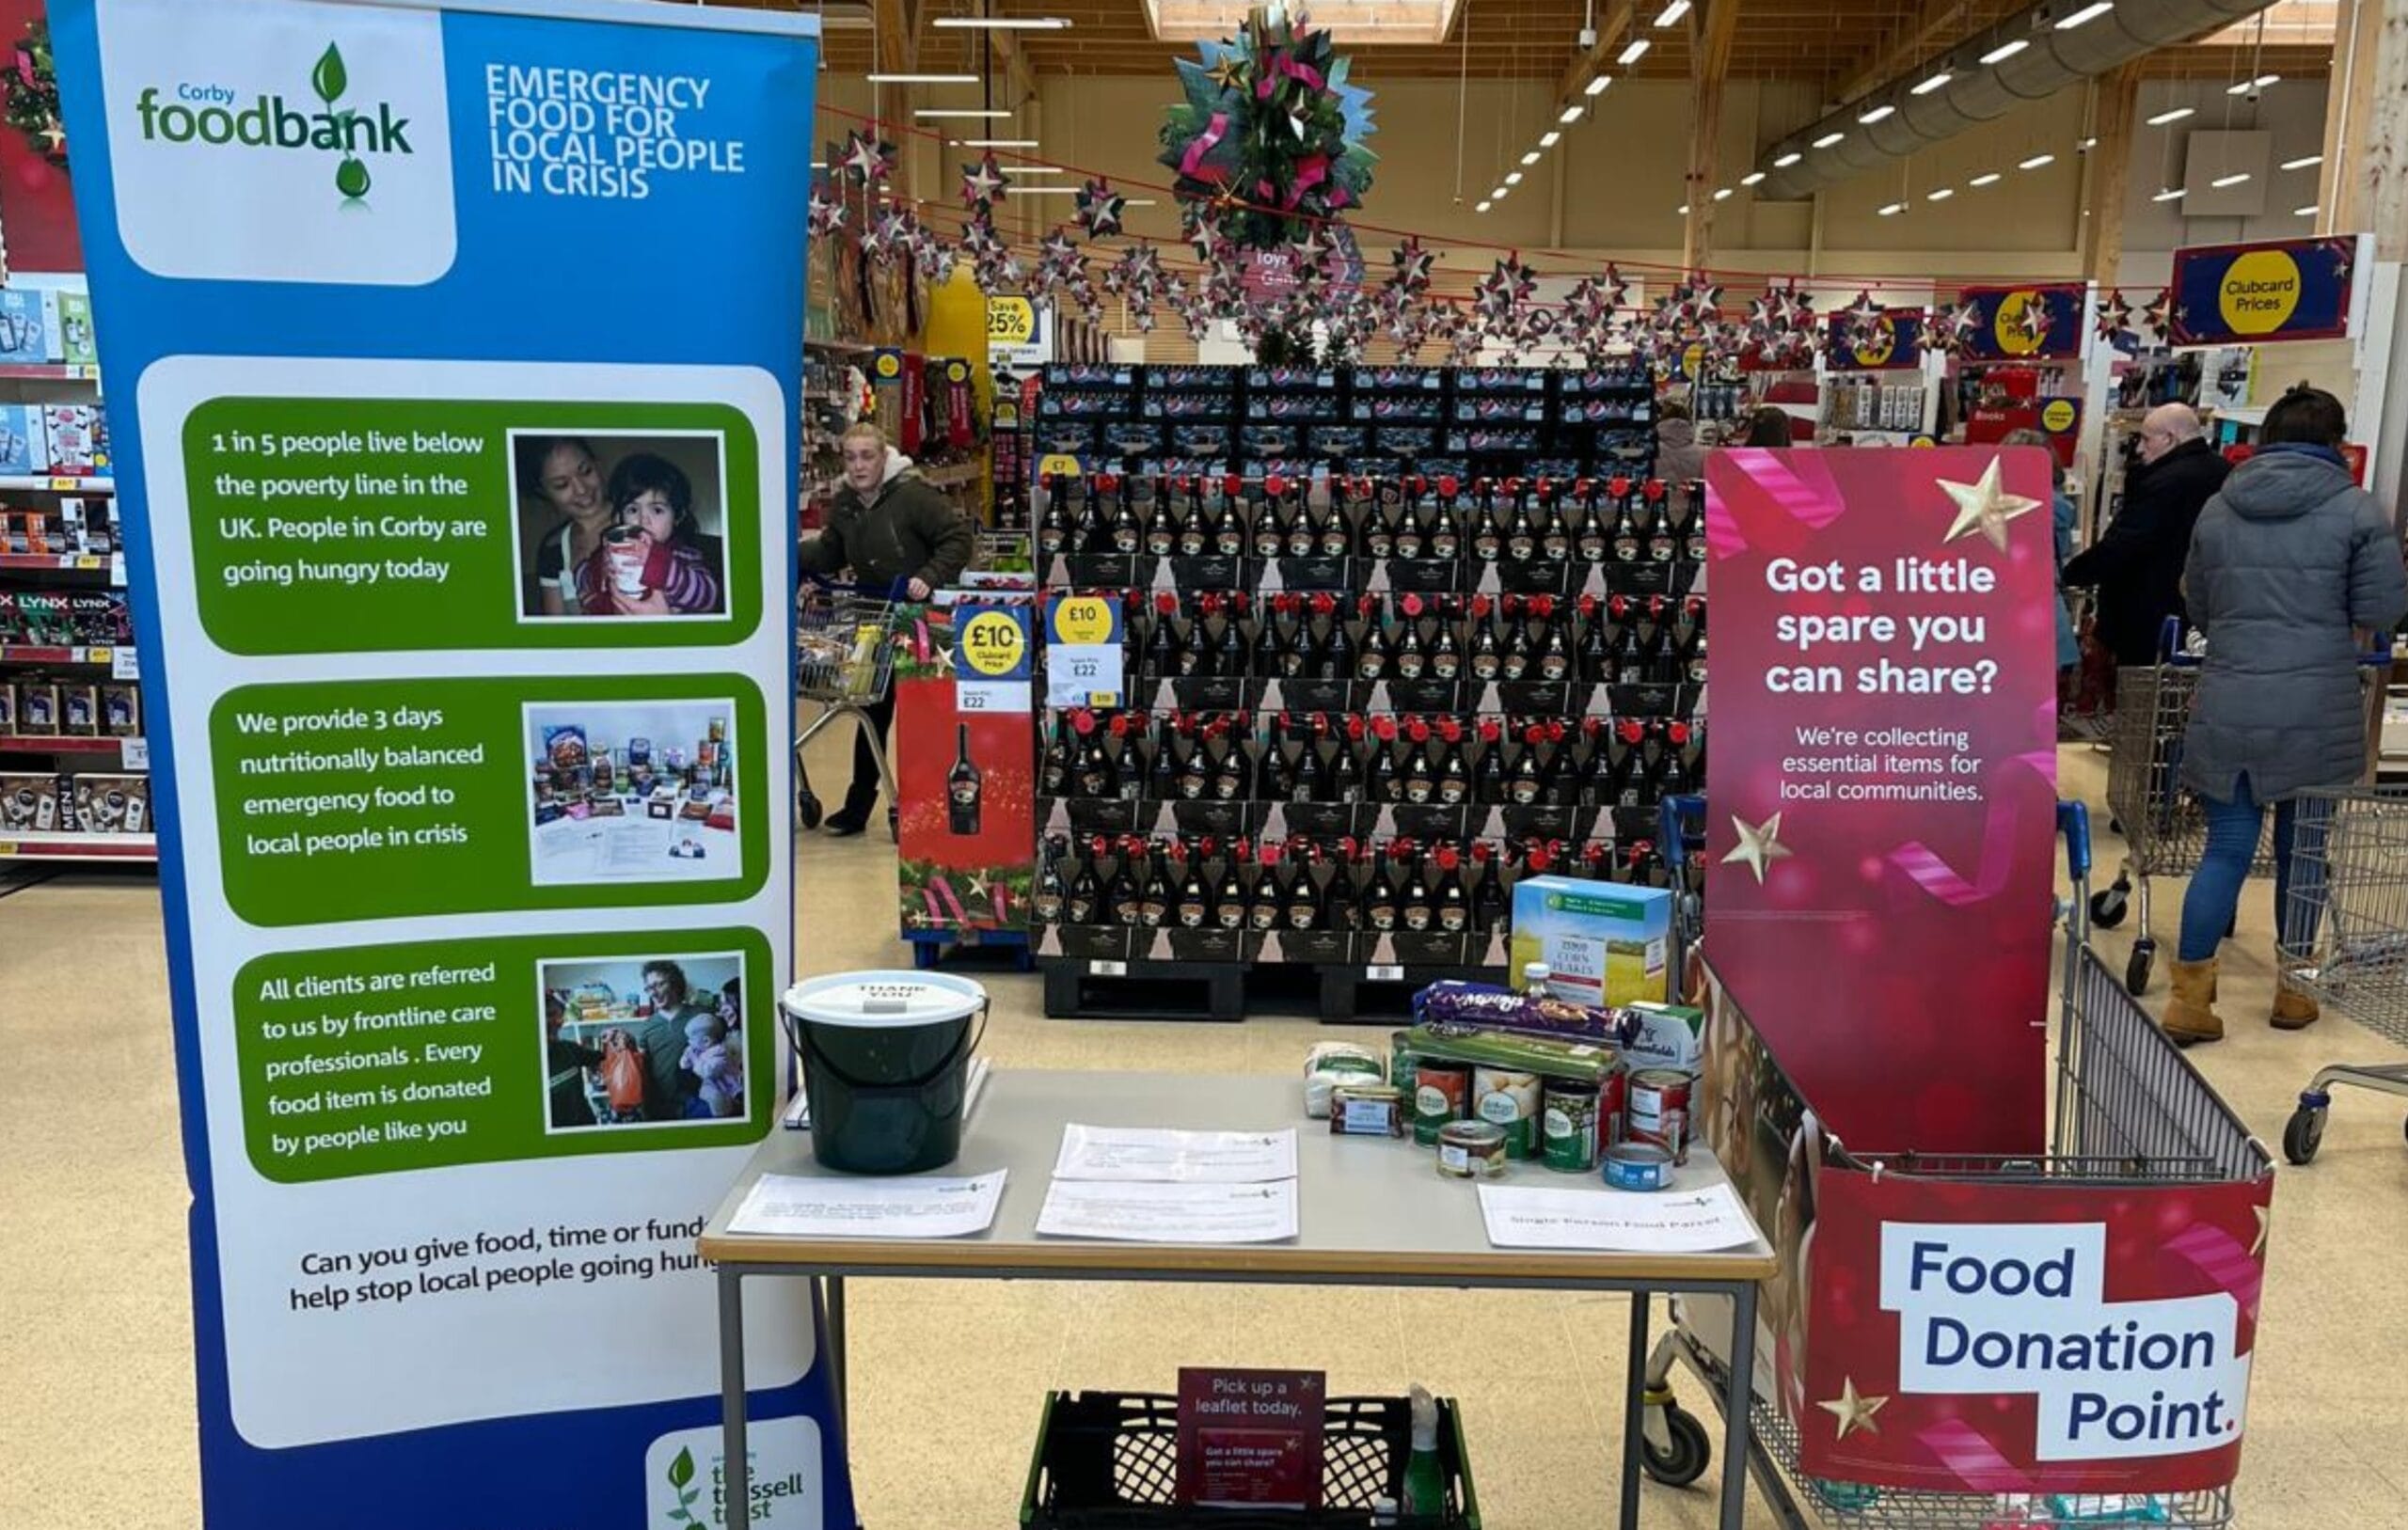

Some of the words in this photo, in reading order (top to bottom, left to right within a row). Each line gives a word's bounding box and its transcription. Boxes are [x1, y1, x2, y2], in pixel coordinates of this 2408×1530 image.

[179, 83, 234, 103] Corby
[485, 64, 710, 109] EMERGENCY
[137, 87, 414, 153] foodbank
[489, 97, 595, 134] FOOD
[607, 105, 676, 137] FOR
[490, 128, 606, 166] LOCAL
[615, 136, 745, 172] PEOPLE
[493, 161, 531, 193] IN
[543, 164, 649, 198] CRISIS
[2226, 277, 2293, 295] Clubcard
[990, 301, 1019, 311] Save
[2236, 297, 2281, 312] Prices
[989, 313, 1026, 333] 25%
[213, 434, 226, 452] 1
[232, 431, 255, 451] in
[261, 434, 276, 455] 5
[282, 431, 361, 457] people
[368, 431, 406, 452] live
[413, 431, 483, 452] below
[215, 474, 255, 495] the
[261, 475, 349, 500] poverty
[355, 474, 398, 495] line
[403, 474, 424, 495] in
[430, 474, 467, 495] the
[219, 518, 262, 538] UK.
[268, 516, 347, 542] People
[353, 516, 374, 536] in
[380, 516, 446, 541] Corby
[451, 520, 486, 536] are
[224, 560, 292, 587] going
[298, 559, 380, 584] hungry
[386, 557, 450, 582] today
[1766, 559, 1846, 592] Got
[1859, 566, 1881, 591] a
[1895, 558, 1995, 592] little
[19, 596, 68, 609] LYNX
[72, 598, 111, 607] LYNX
[1069, 606, 1097, 621] £10
[972, 624, 1015, 647] £10
[1777, 615, 1896, 651] spare
[1909, 616, 1985, 651] you
[1073, 664, 1097, 676] £22
[1766, 666, 1843, 692] can
[1857, 659, 1998, 693] share?
[963, 697, 985, 708] £22
[236, 713, 277, 733] We
[283, 709, 368, 736] provide
[374, 711, 388, 730] 3
[393, 706, 443, 731] days
[1796, 727, 1858, 748] We're
[1864, 727, 1969, 751] collecting
[241, 748, 379, 774] nutritionally
[385, 743, 483, 766] balanced
[1782, 754, 1877, 773] essential
[1885, 754, 1943, 773] items
[1950, 754, 1981, 773] for
[244, 794, 369, 816] emergency
[374, 785, 425, 807] food
[432, 787, 455, 804] to
[1781, 780, 1831, 799] local
[1837, 781, 1983, 801] communities.
[61, 790, 75, 830] MEN
[247, 832, 301, 855] local
[306, 828, 383, 856] people
[388, 827, 408, 845] in
[415, 823, 467, 844] crisis
[260, 978, 290, 1002] All
[295, 975, 365, 998] clients
[370, 972, 404, 991] are
[410, 962, 496, 987] referred
[262, 1022, 286, 1039] to
[293, 1020, 317, 1036] us
[323, 1015, 348, 1037] by
[354, 1006, 446, 1031] frontline
[452, 1005, 497, 1022] care
[266, 1046, 409, 1081] professionals
[425, 1043, 483, 1063] Every
[268, 1092, 320, 1115] food
[325, 1091, 376, 1110] item
[380, 1085, 398, 1103] is
[403, 1076, 491, 1102] donated
[272, 1134, 299, 1157] by
[305, 1126, 380, 1153] people
[385, 1121, 422, 1141] like
[427, 1120, 467, 1142] you
[300, 1254, 352, 1275] Can
[357, 1250, 407, 1274] you
[414, 1238, 468, 1267] give
[475, 1227, 543, 1255] food,
[547, 1223, 607, 1248] time
[613, 1226, 642, 1242] or
[290, 1288, 350, 1311] help
[356, 1278, 413, 1302] stop
[420, 1266, 479, 1294] local
[486, 1260, 574, 1290] people
[580, 1254, 654, 1283] going
[1909, 1240, 2075, 1298] Food
[1925, 1317, 2214, 1371] Donation
[1212, 1378, 1246, 1395] Pick
[1251, 1381, 1274, 1397] up
[1277, 1383, 1287, 1395] a
[1196, 1397, 1247, 1414] leaflet
[1253, 1400, 1303, 1420] today.
[2067, 1390, 2235, 1441] Point.
[712, 1465, 754, 1485] te
[713, 1474, 803, 1505] tssell
[713, 1501, 772, 1523] tst
